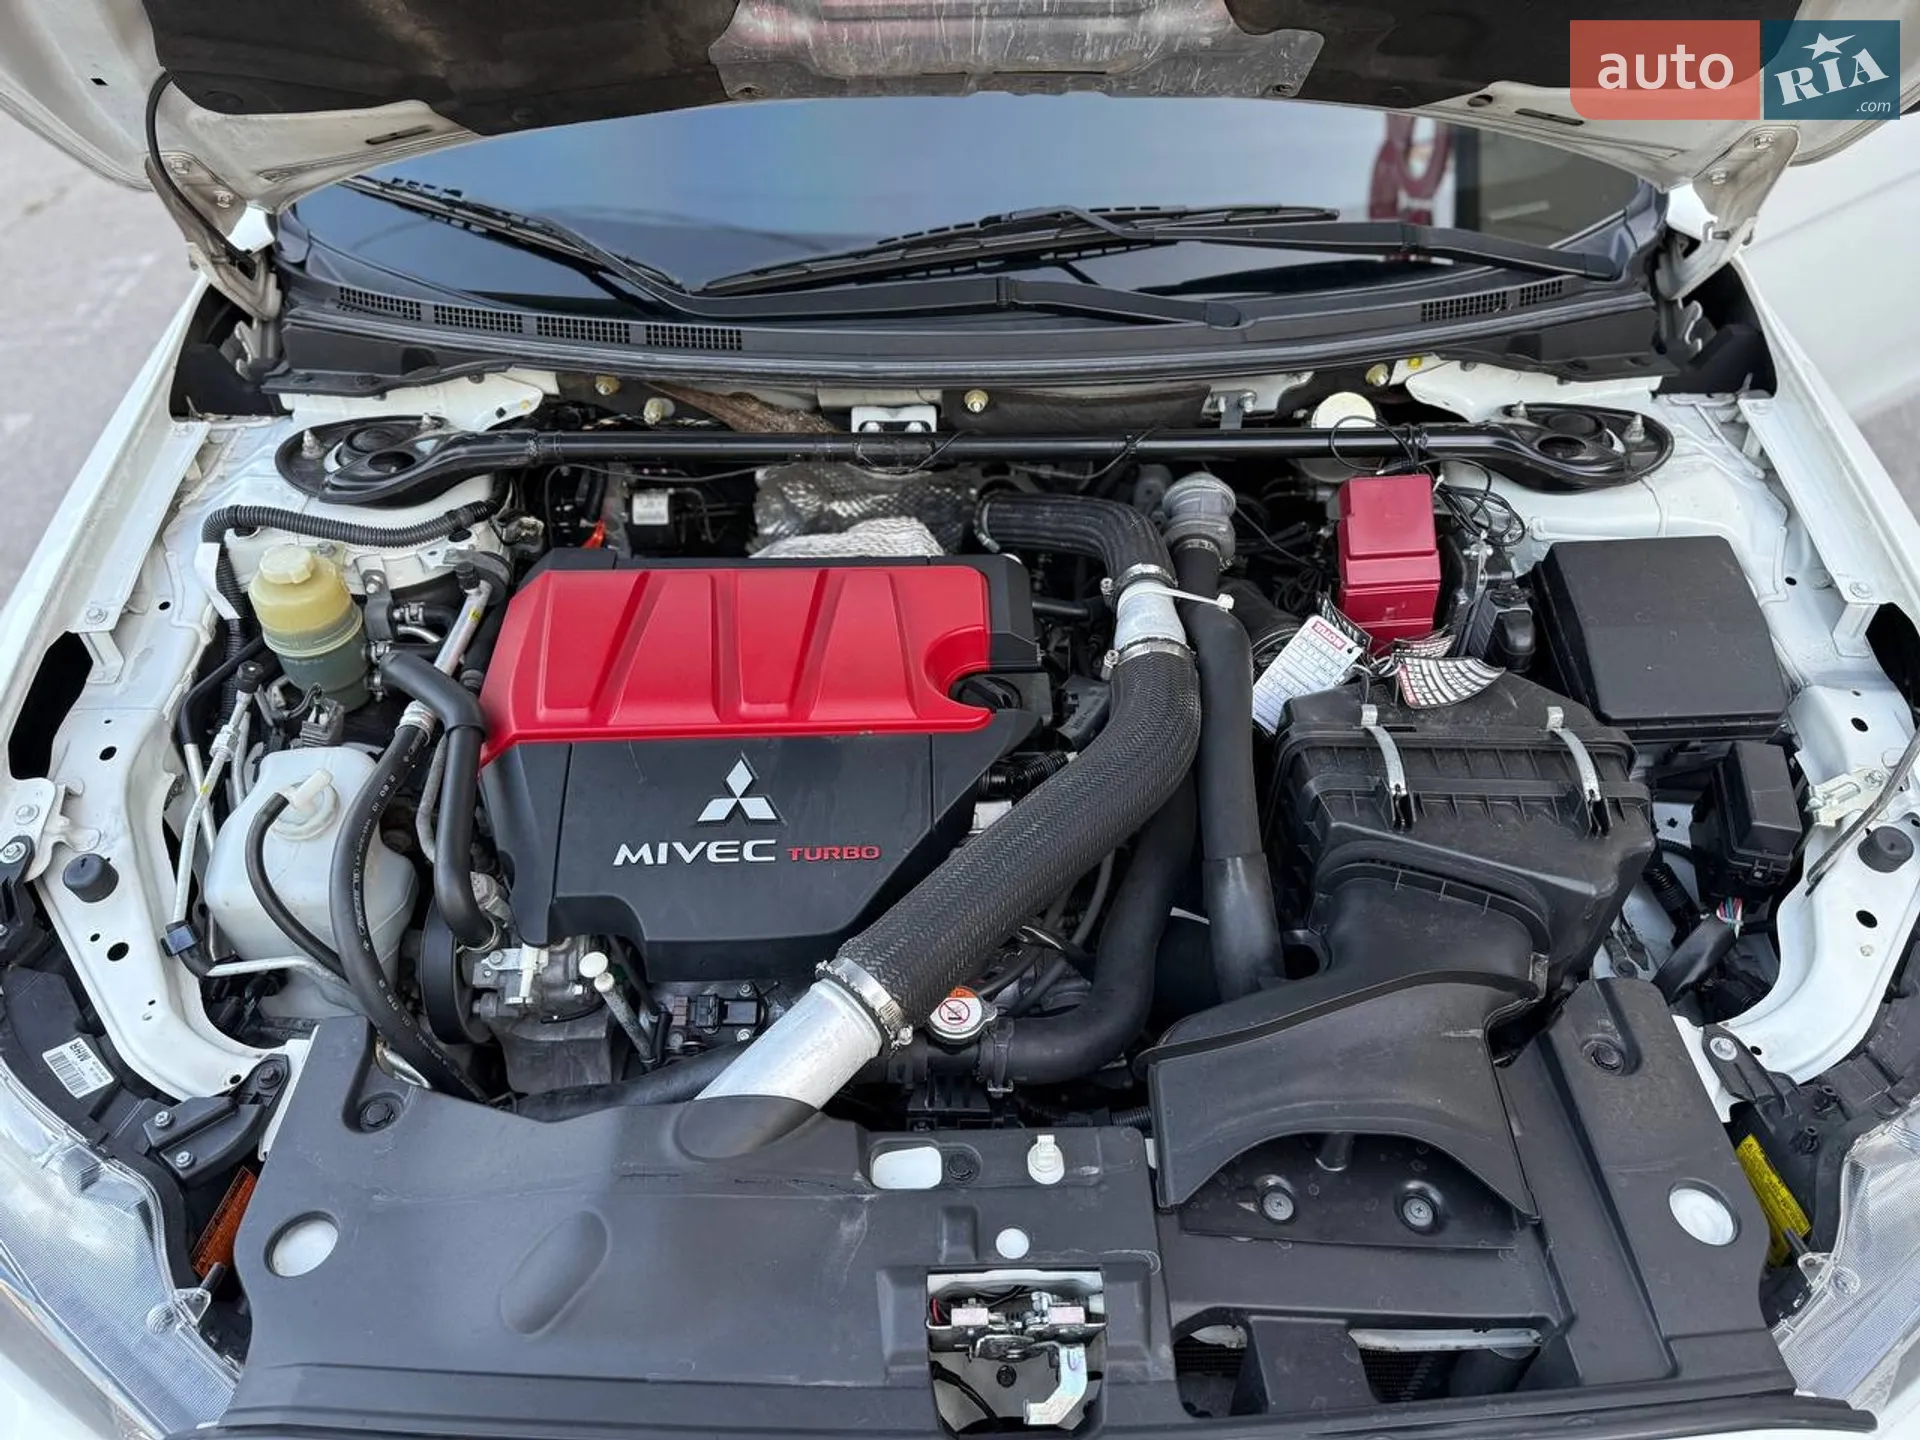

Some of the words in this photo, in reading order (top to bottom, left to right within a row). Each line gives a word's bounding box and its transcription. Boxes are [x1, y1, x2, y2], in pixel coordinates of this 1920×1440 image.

[1314, 622, 1346, 649] MOTUL
[613, 839, 777, 866] MIVEC
[787, 846, 881, 861] TURBO
